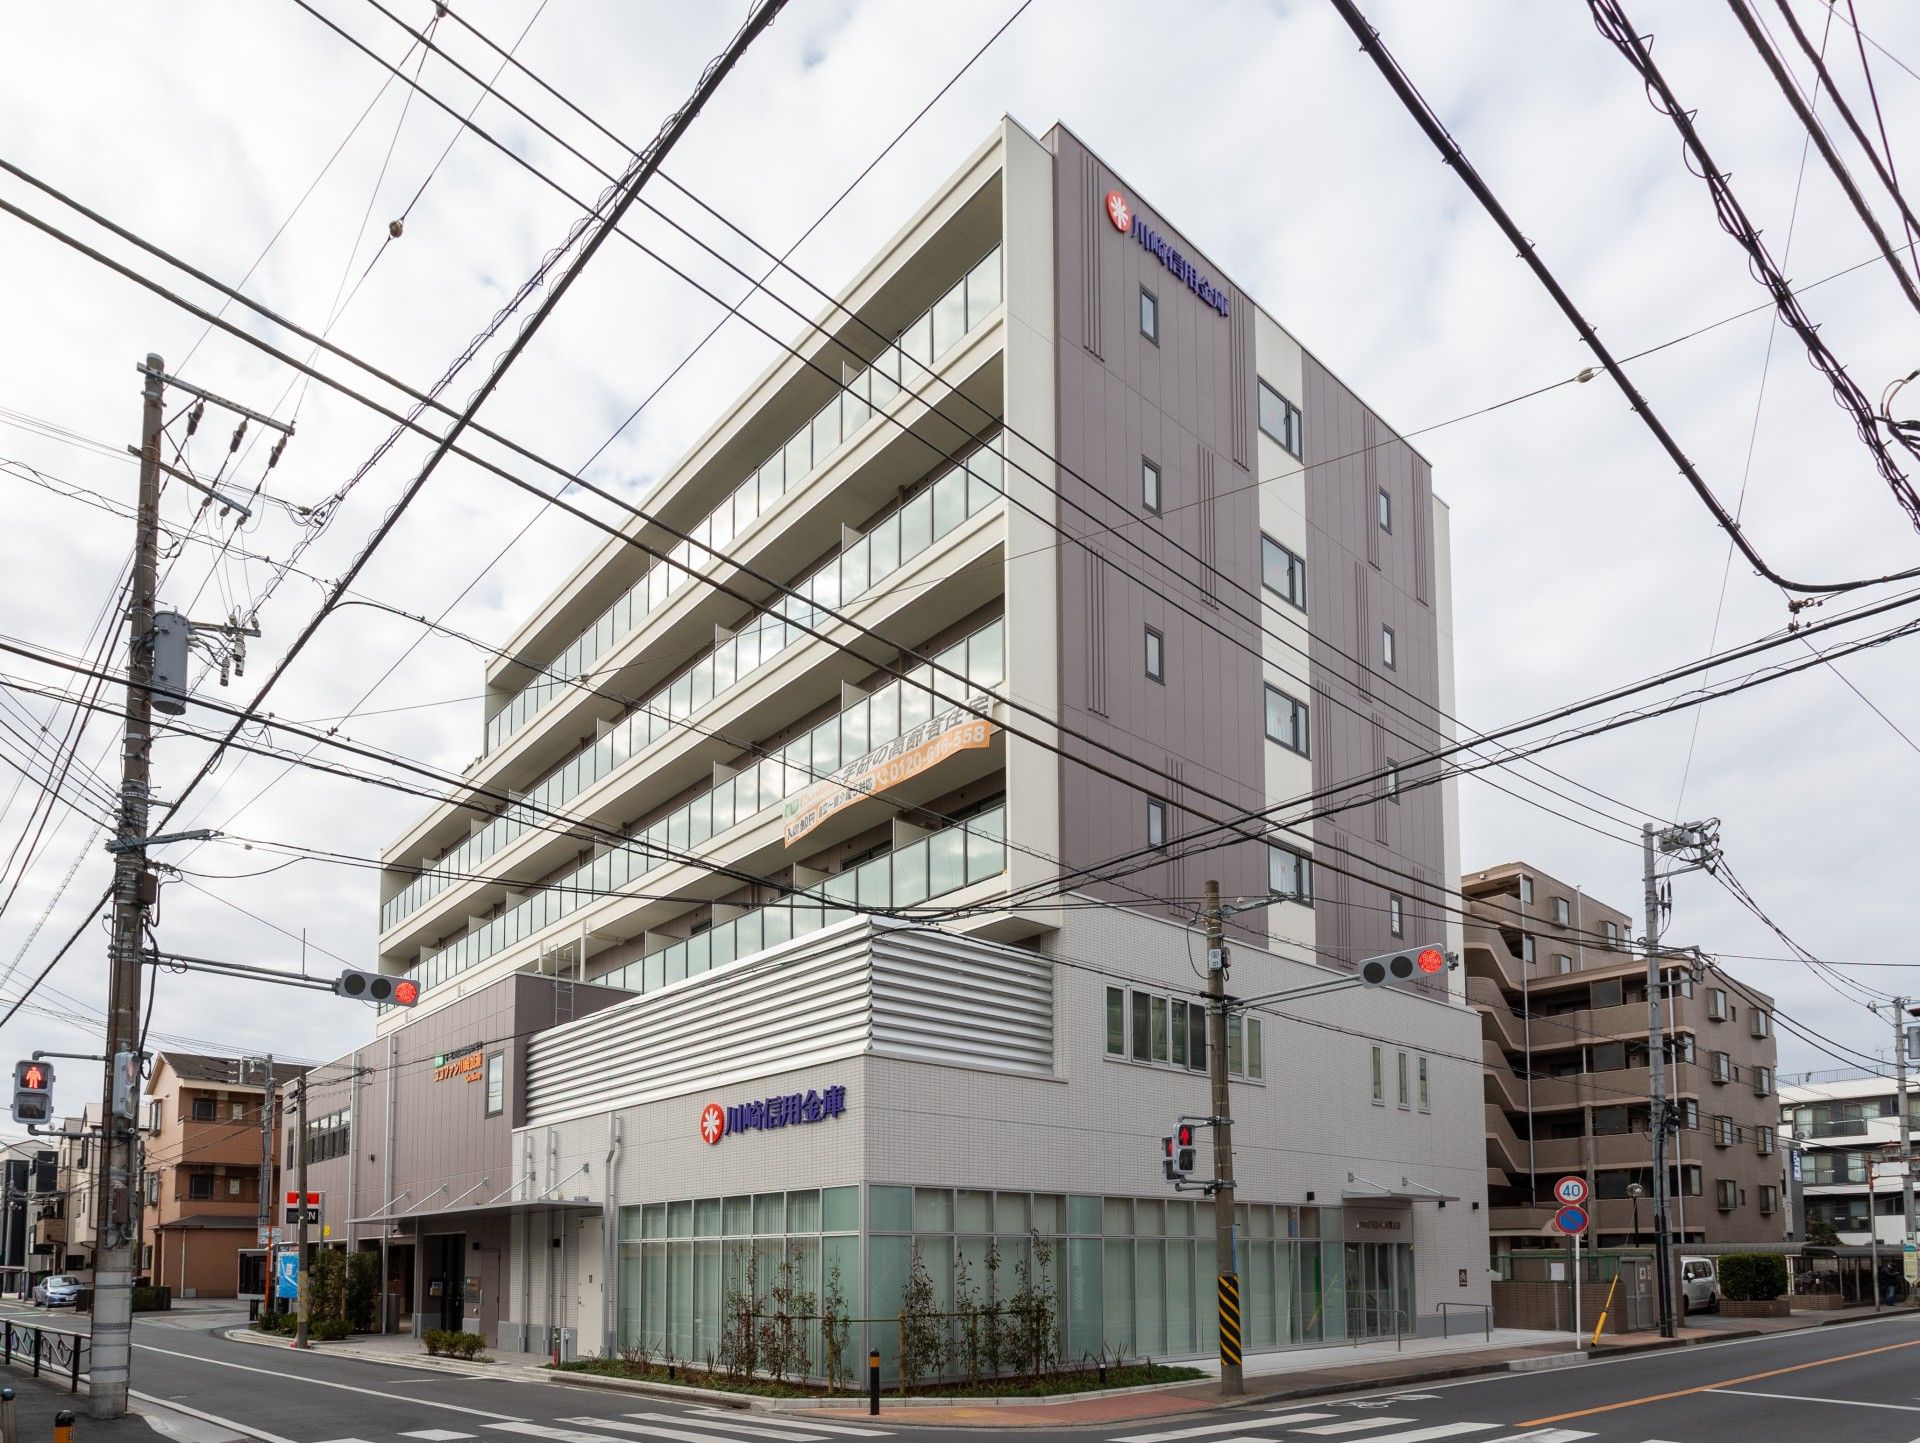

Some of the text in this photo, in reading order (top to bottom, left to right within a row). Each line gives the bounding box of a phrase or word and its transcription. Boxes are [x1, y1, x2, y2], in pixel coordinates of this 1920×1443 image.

[1131, 213, 1229, 318] 川崎信用金庫
[725, 1085, 846, 1136] 川崎信用金庫
[1562, 1184, 1581, 1197] 40
